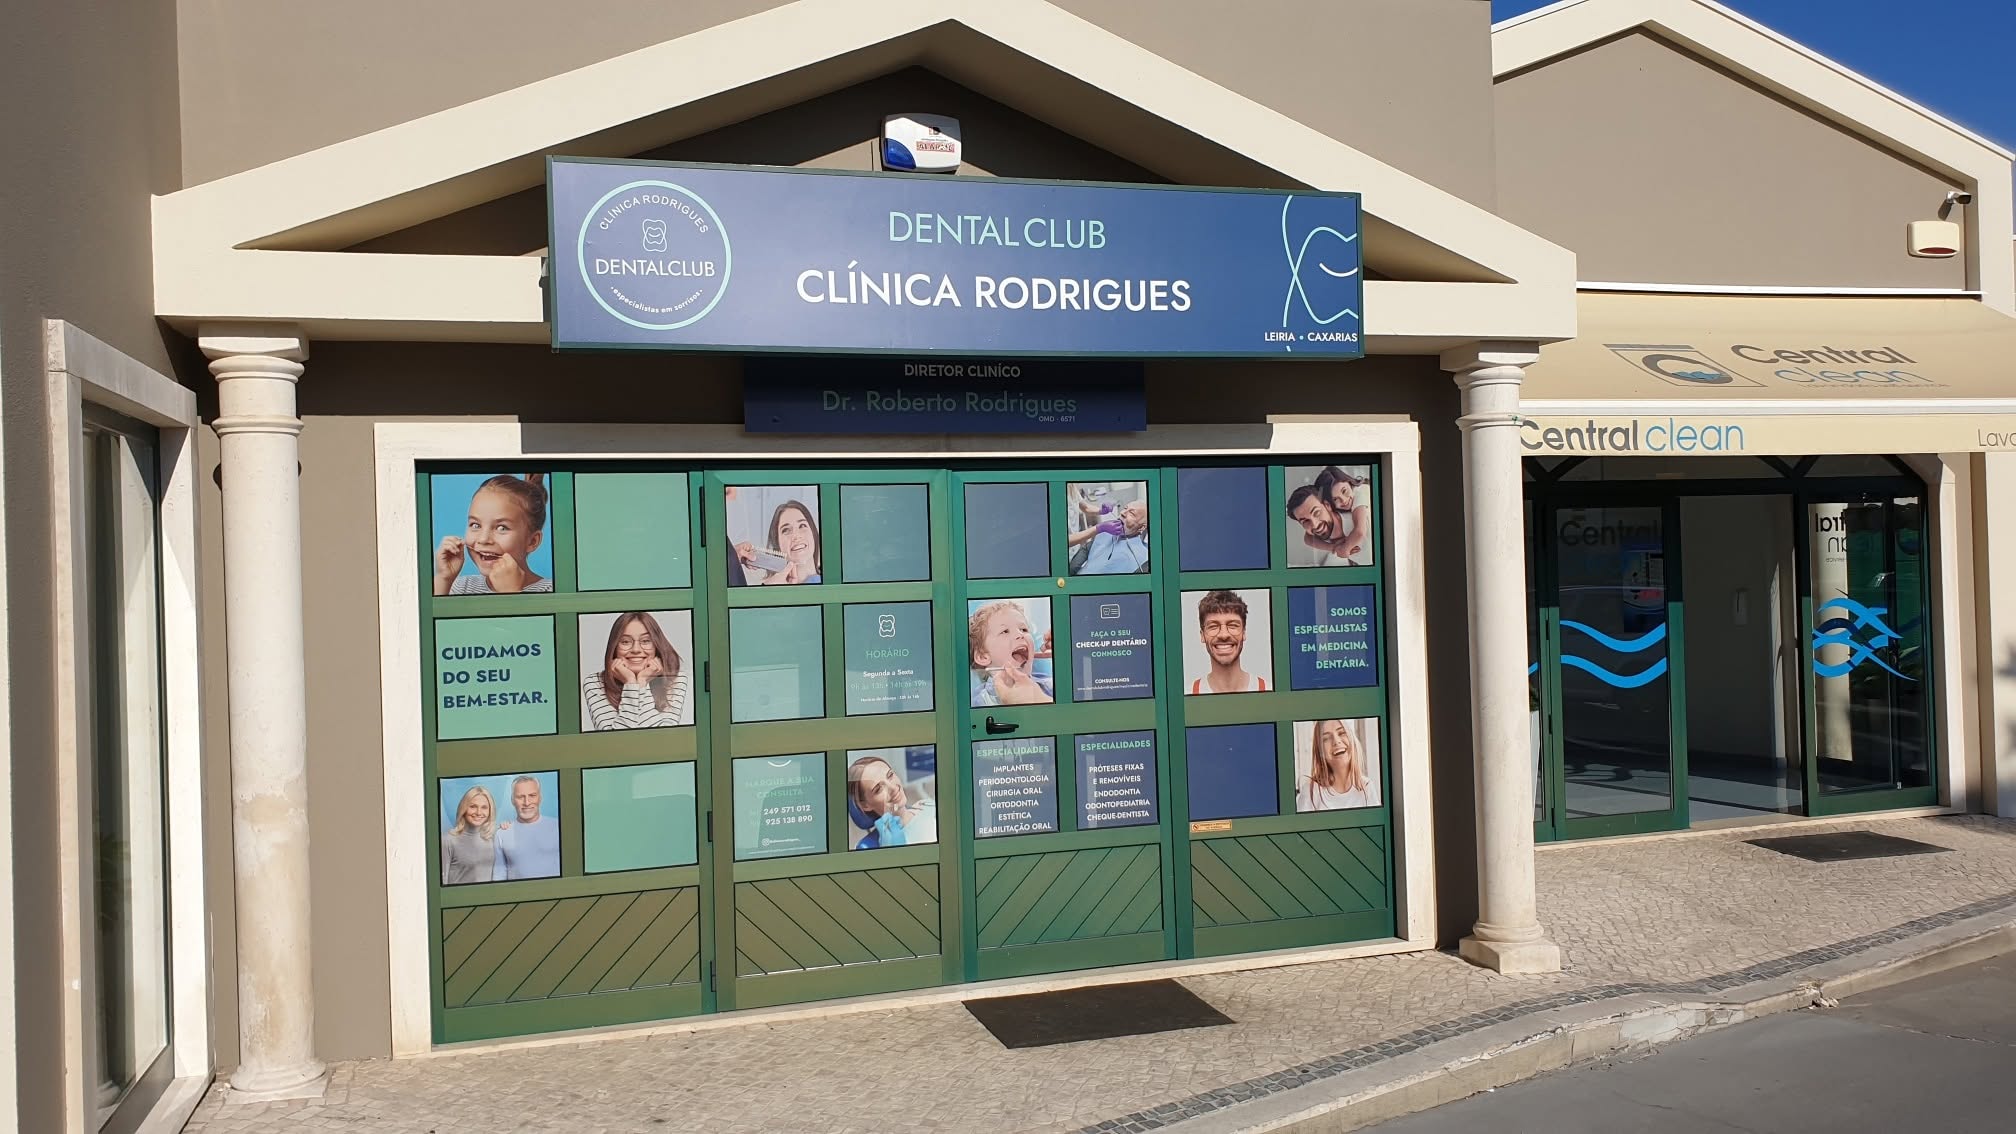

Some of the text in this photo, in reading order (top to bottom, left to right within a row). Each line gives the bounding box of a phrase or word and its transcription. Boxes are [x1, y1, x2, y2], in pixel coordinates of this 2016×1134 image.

[599, 194, 709, 233] CLÍNICA RODRIGUES
[595, 258, 715, 277] DENTALCLUB
[796, 259, 1191, 312] CLÍNICA RODRIGUES
[613, 287, 659, 313] especialistas
[674, 291, 701, 311] sorrisos
[1264, 331, 1358, 342] LEIRIA CAXARIAS
[1730, 344, 1917, 365] Central
[904, 362, 1021, 378] DIRETOR CLINÍCO
[1774, 365, 1934, 383] clean
[823, 389, 1077, 419] Dr. Roberto Rodrigues
[1520, 417, 1744, 451] Central clean
[1330, 606, 1367, 617] SOMOS
[1090, 630, 1109, 639] FAÇA
[1294, 623, 1368, 635] ESPECIALISTAS
[1076, 637, 1147, 649] CHECK-UP DENTÁRIO
[1301, 641, 1368, 652] EM MEDICINA
[441, 643, 542, 661] CUIDAMOS
[865, 647, 910, 659] HORÁRIO
[1091, 649, 1132, 658] CONNOSCO
[1316, 656, 1369, 669] DENTÁRIA.
[442, 668, 511, 684] DO SEU
[863, 668, 890, 679] Segunda
[443, 690, 548, 709] BEM-ESTAR.
[976, 745, 1049, 757] ESPECIALIDADES
[1080, 740, 1151, 752] ESPECIALIDADES
[993, 763, 1034, 773] IMPLANTES
[1089, 763, 1144, 773] PRÓTESES FIXAS
[978, 774, 1049, 786] PERIODONTOLOGIA
[1099, 774, 1141, 785] REMOVÍVEIS
[986, 787, 1043, 798] CIRURGIA ORAL
[1094, 788, 1141, 798] ENDODONTIA
[763, 804, 811, 815] 249 571 012
[990, 799, 1039, 809] ORTODONTIA
[1085, 799, 1151, 810] ODONTOPEDIATRIA
[797, 815, 813, 823] 890
[998, 811, 1032, 821] ESTÉTICA
[1087, 810, 1150, 821] CHEQUE-DENTISTA
[978, 822, 1052, 834] REABILITAÇÃO ORAL
